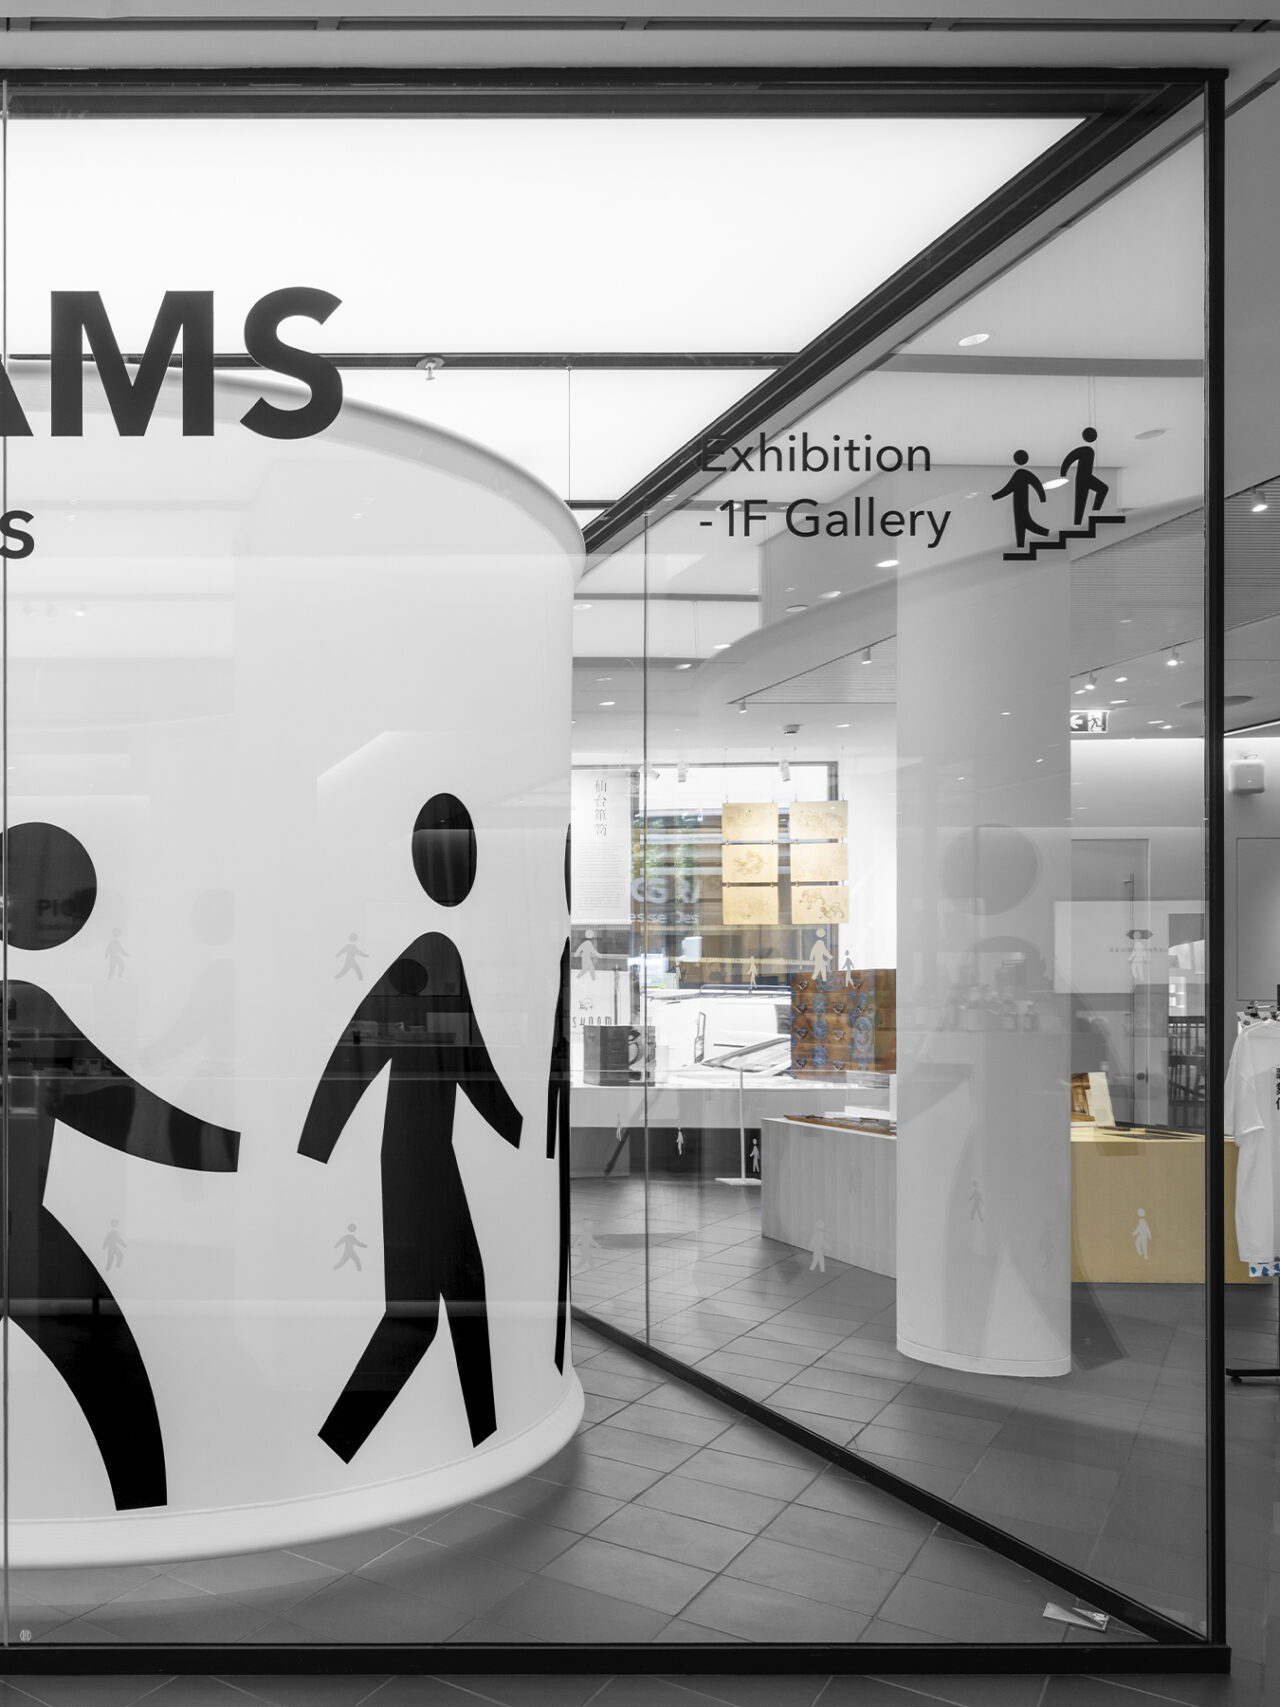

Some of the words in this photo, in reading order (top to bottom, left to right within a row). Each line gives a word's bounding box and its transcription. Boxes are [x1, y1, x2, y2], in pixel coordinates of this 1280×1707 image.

[701, 432, 931, 472] Exhibition
[700, 500, 767, 537] -1F
[786, 496, 951, 548] Gallery
